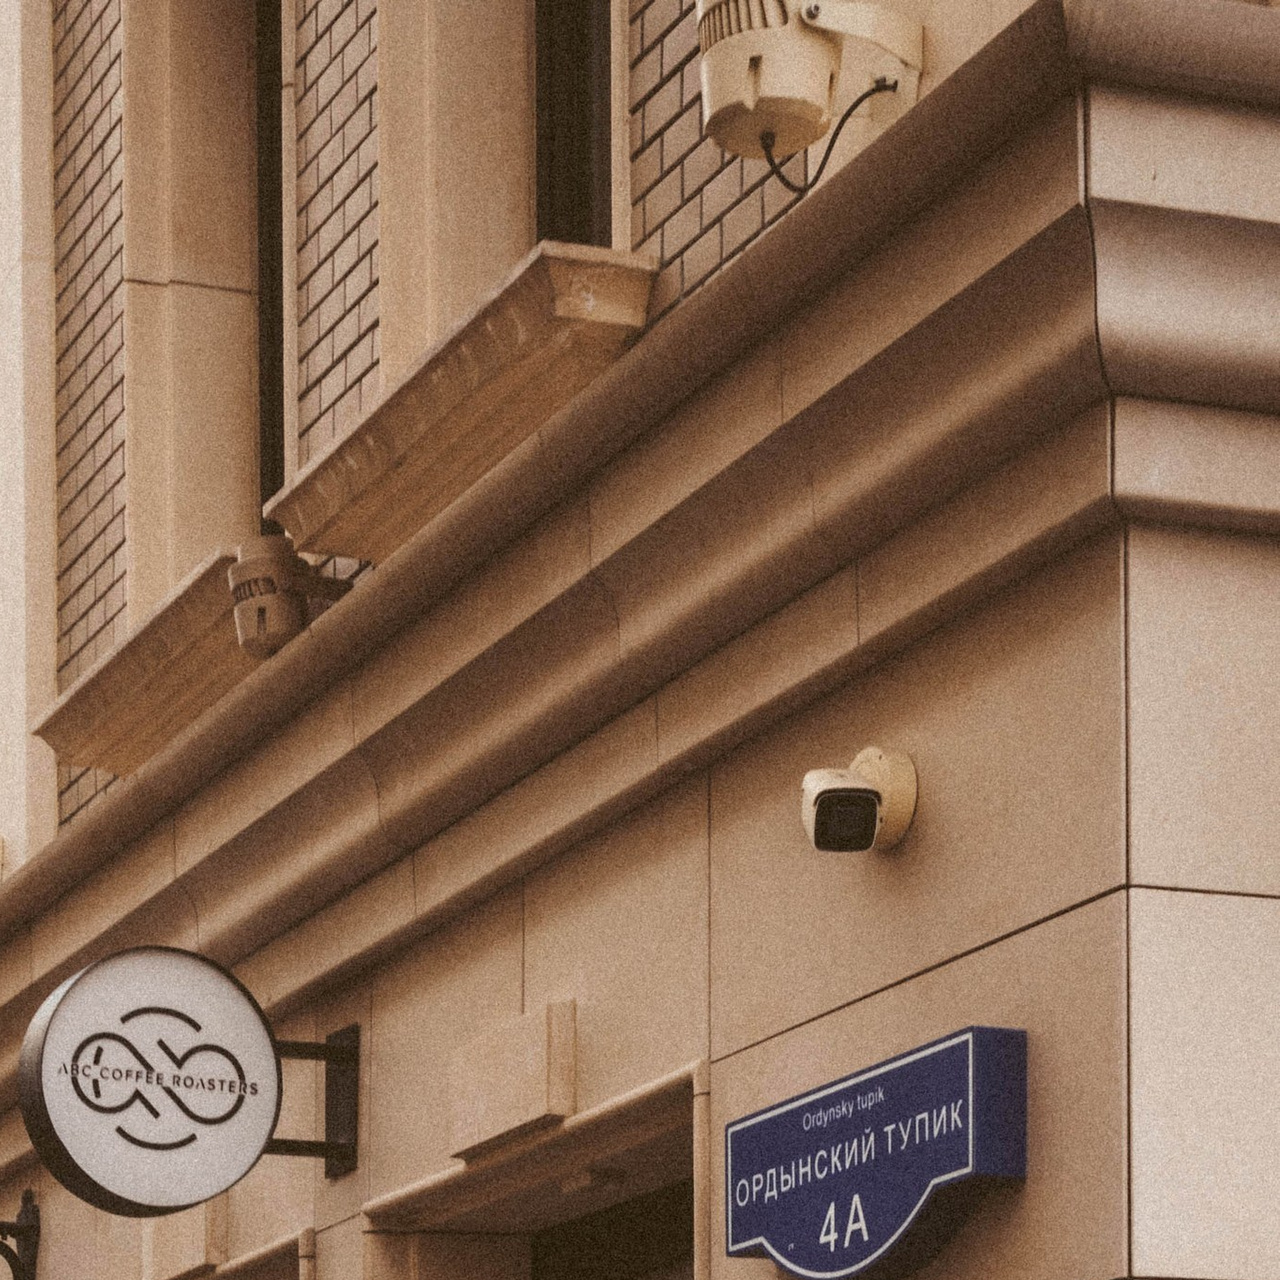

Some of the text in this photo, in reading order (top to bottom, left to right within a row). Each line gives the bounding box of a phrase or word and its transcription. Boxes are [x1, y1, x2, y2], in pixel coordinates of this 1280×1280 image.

[57, 1063, 259, 1096] ABC COFFEE ROASTERS
[802, 1086, 885, 1131] Ordynsky tupik
[736, 1099, 963, 1207] ОРДЫНСКИЙ ТУПИК
